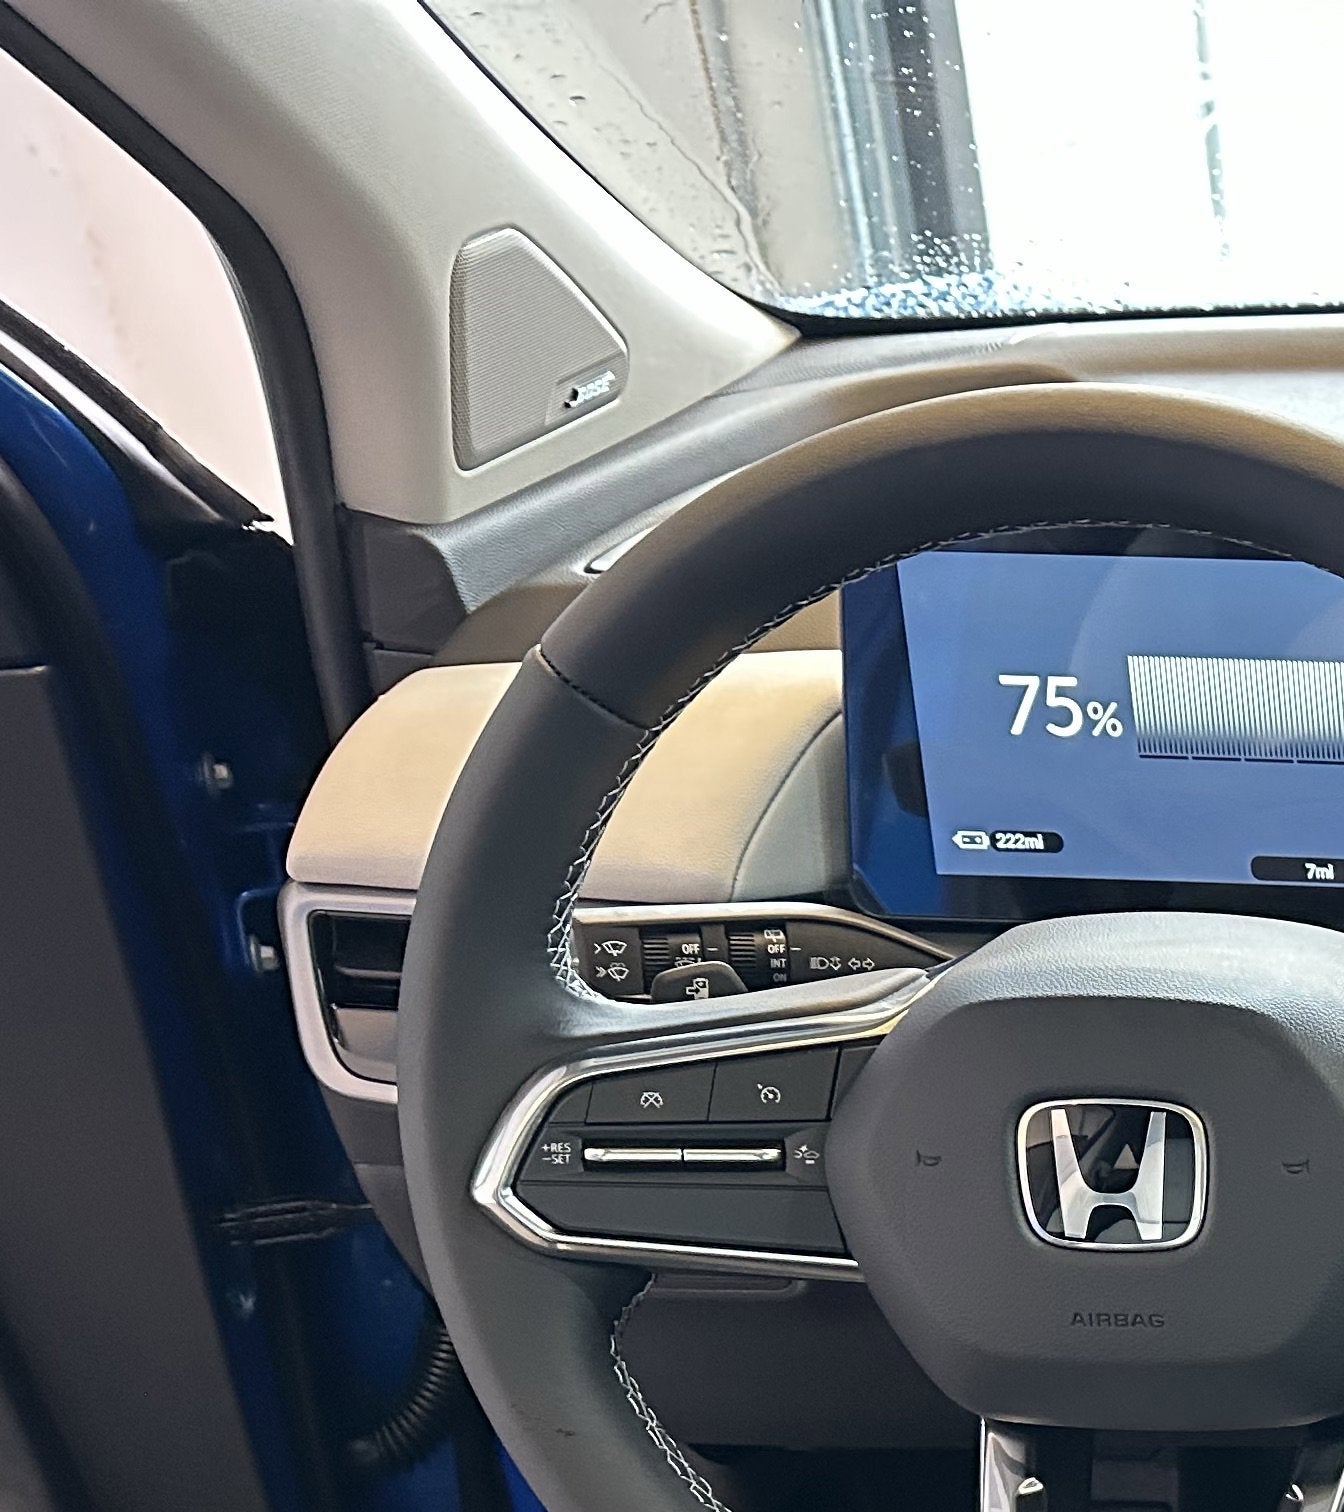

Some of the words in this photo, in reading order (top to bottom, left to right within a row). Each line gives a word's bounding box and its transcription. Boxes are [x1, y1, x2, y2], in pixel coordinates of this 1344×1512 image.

[998, 674, 1123, 737] 75%
[995, 832, 1045, 850] 222mi
[1304, 862, 1335, 880] 7mi
[681, 943, 700, 955] OFF
[767, 943, 786, 955] OFF
[770, 958, 786, 969] INT
[772, 972, 787, 983] ON
[541, 1141, 572, 1154] +RES
[1069, 1311, 1167, 1329] AIRBAG
